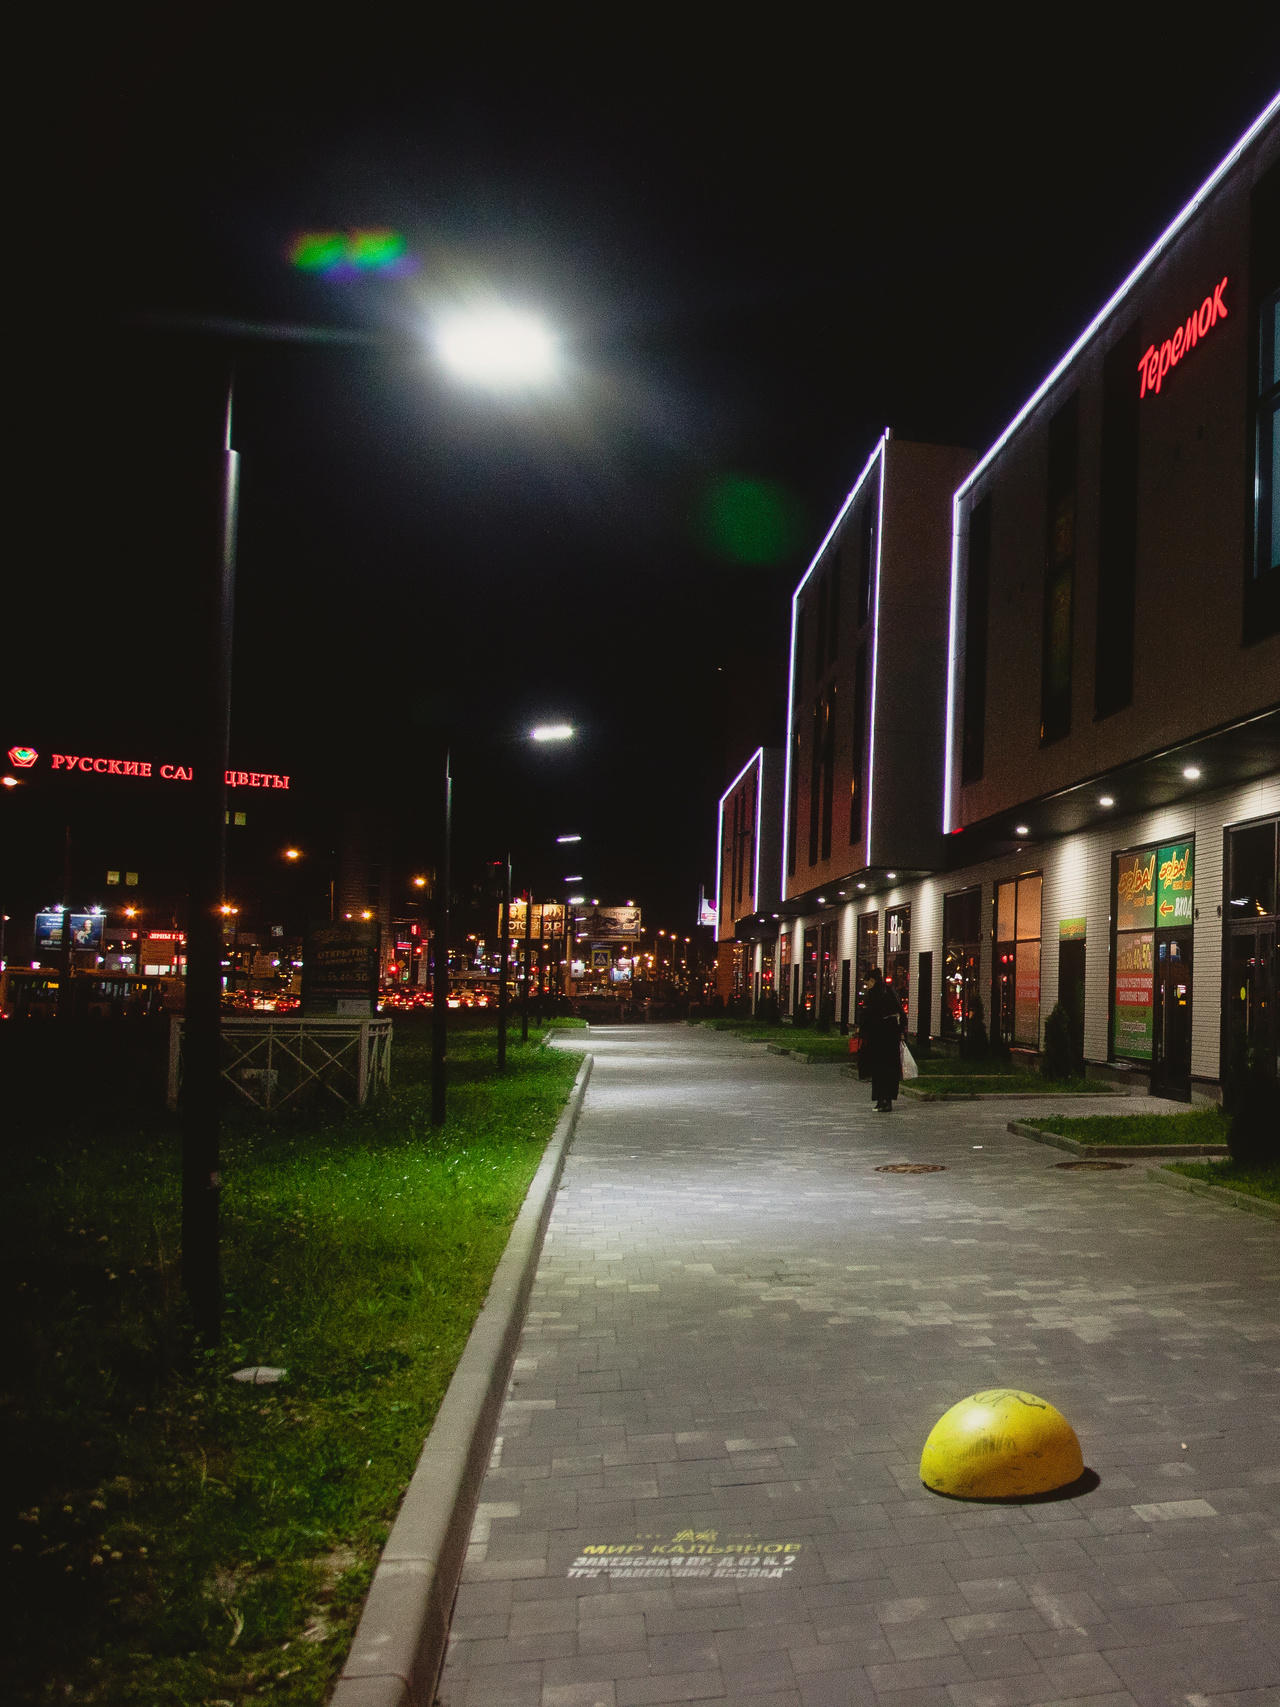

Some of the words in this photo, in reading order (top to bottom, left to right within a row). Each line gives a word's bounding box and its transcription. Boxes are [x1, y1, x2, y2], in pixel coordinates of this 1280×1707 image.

[1138, 276, 1228, 399] Теремок
[51, 754, 152, 777] РУССКИЕ
[159, 764, 290, 790] САЦВЕТЫ
[583, 1545, 644, 1555] МИР
[651, 1543, 802, 1555] КАЛЬЯНОВ
